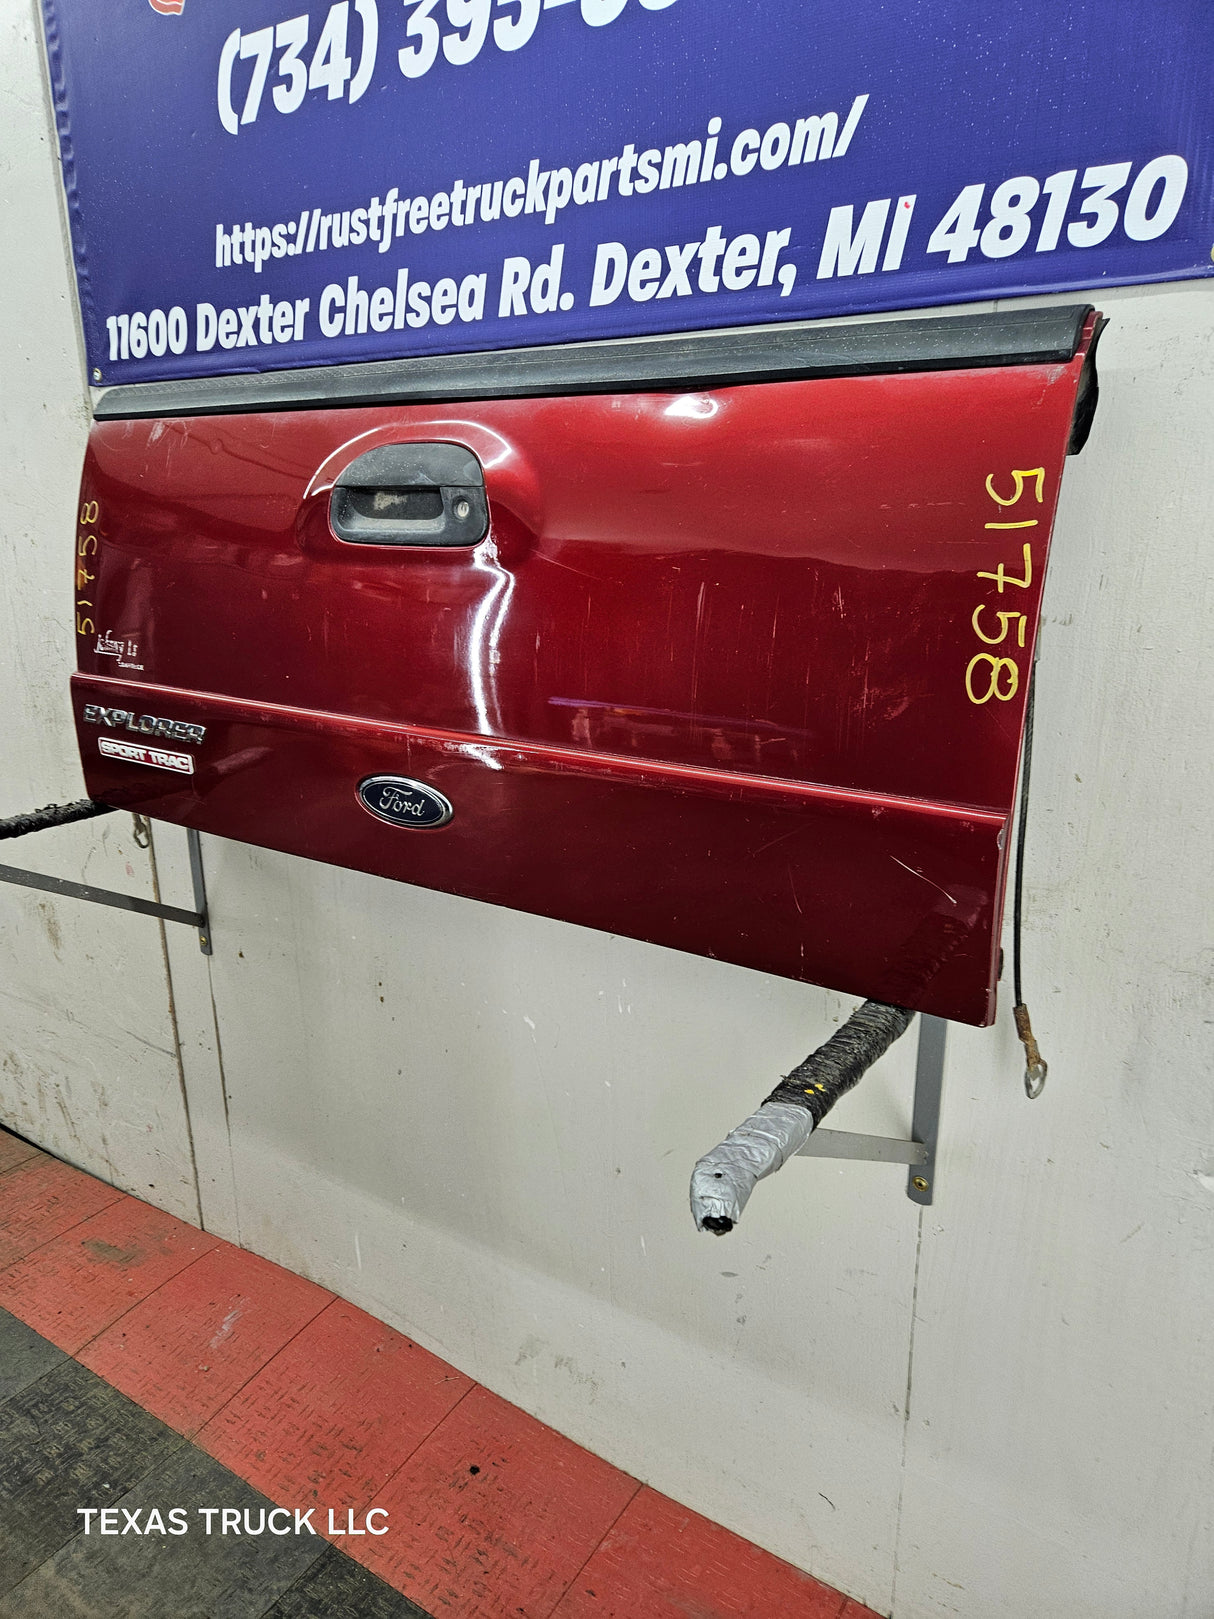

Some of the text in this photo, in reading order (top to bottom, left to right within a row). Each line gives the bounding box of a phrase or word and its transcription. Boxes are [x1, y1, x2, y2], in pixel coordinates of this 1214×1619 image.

[217, 0, 378, 135] (734)
[215, 94, 870, 269] https://rustfreetruckpartsmi.com/
[106, 154, 1189, 361] 11600 Dexter Chelsea Rd. Dexter, MI 48130
[965, 467, 1045, 704] 51758
[83, 703, 207, 745] EXPLORER
[101, 741, 189, 771] SPORT TRAC
[379, 786, 425, 816] Ford
